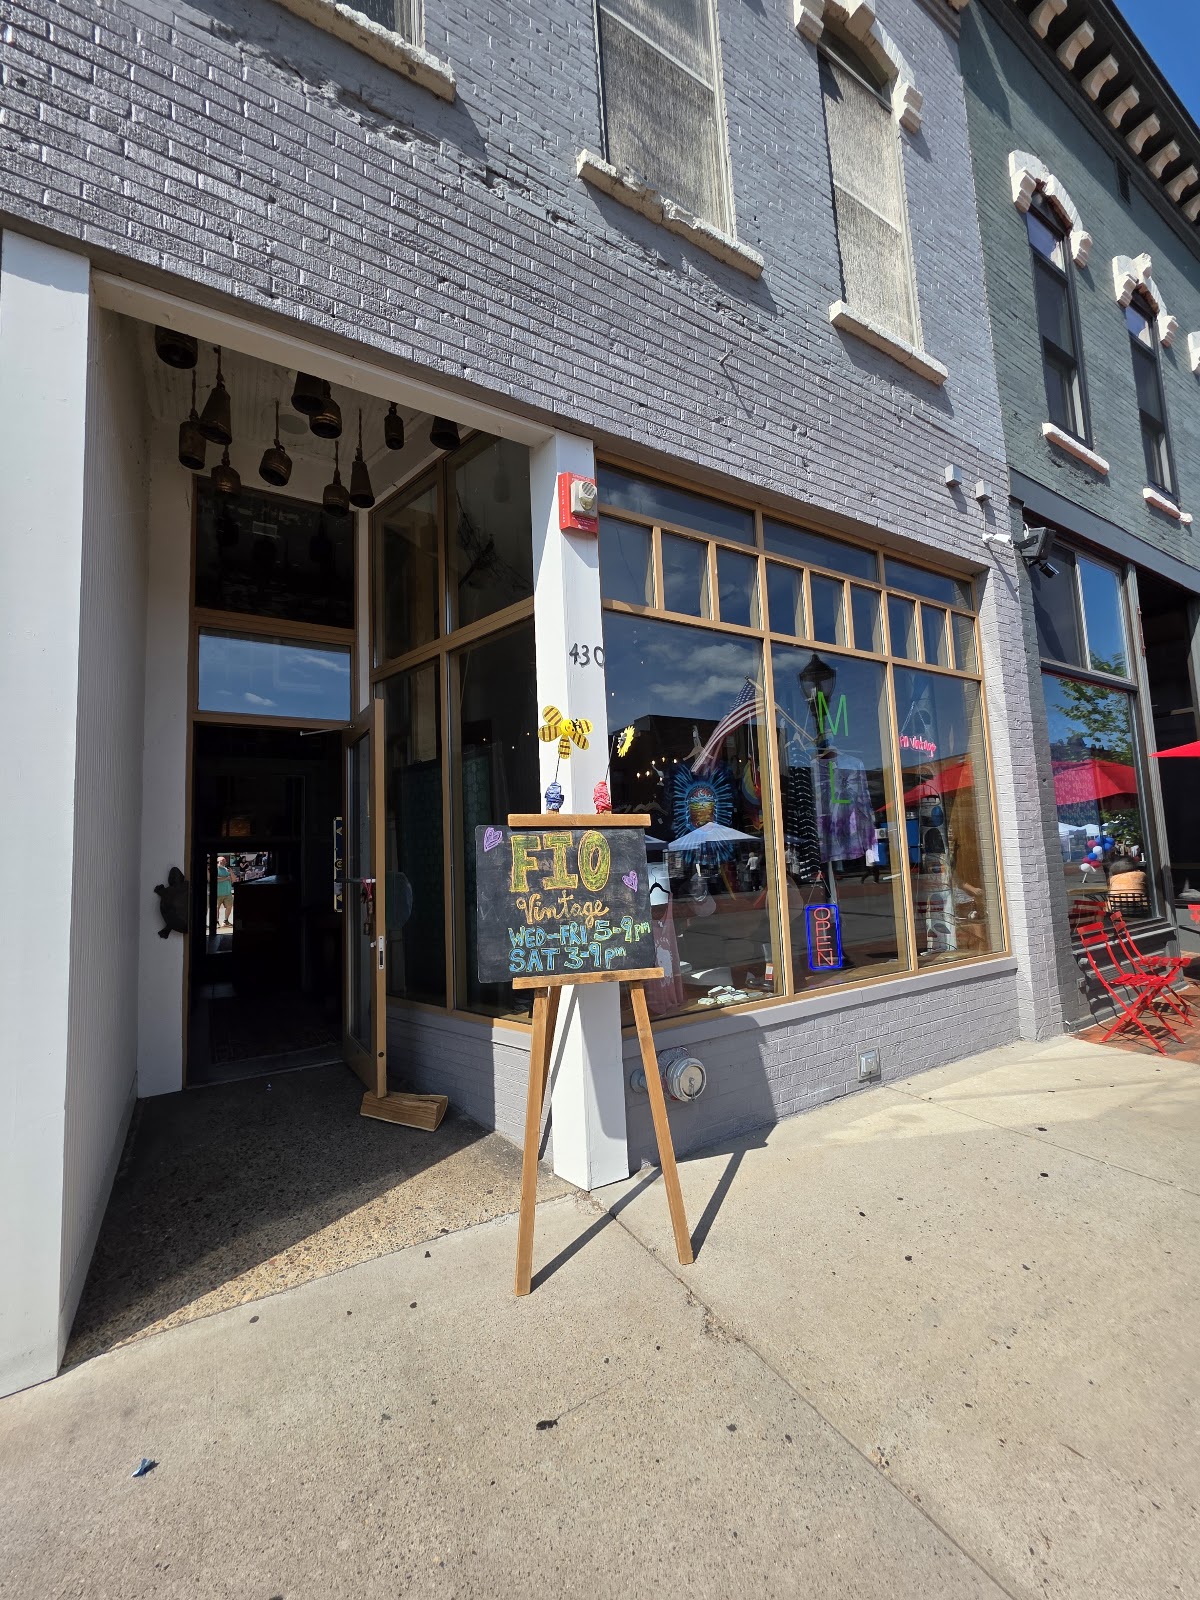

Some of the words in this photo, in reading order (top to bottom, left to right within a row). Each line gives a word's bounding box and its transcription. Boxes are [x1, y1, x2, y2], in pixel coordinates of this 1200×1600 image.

[569, 642, 605, 669] 430
[509, 829, 611, 893] FIO
[516, 890, 610, 929] Vintage
[813, 907, 834, 966] OPEN
[509, 947, 560, 973] SAT
